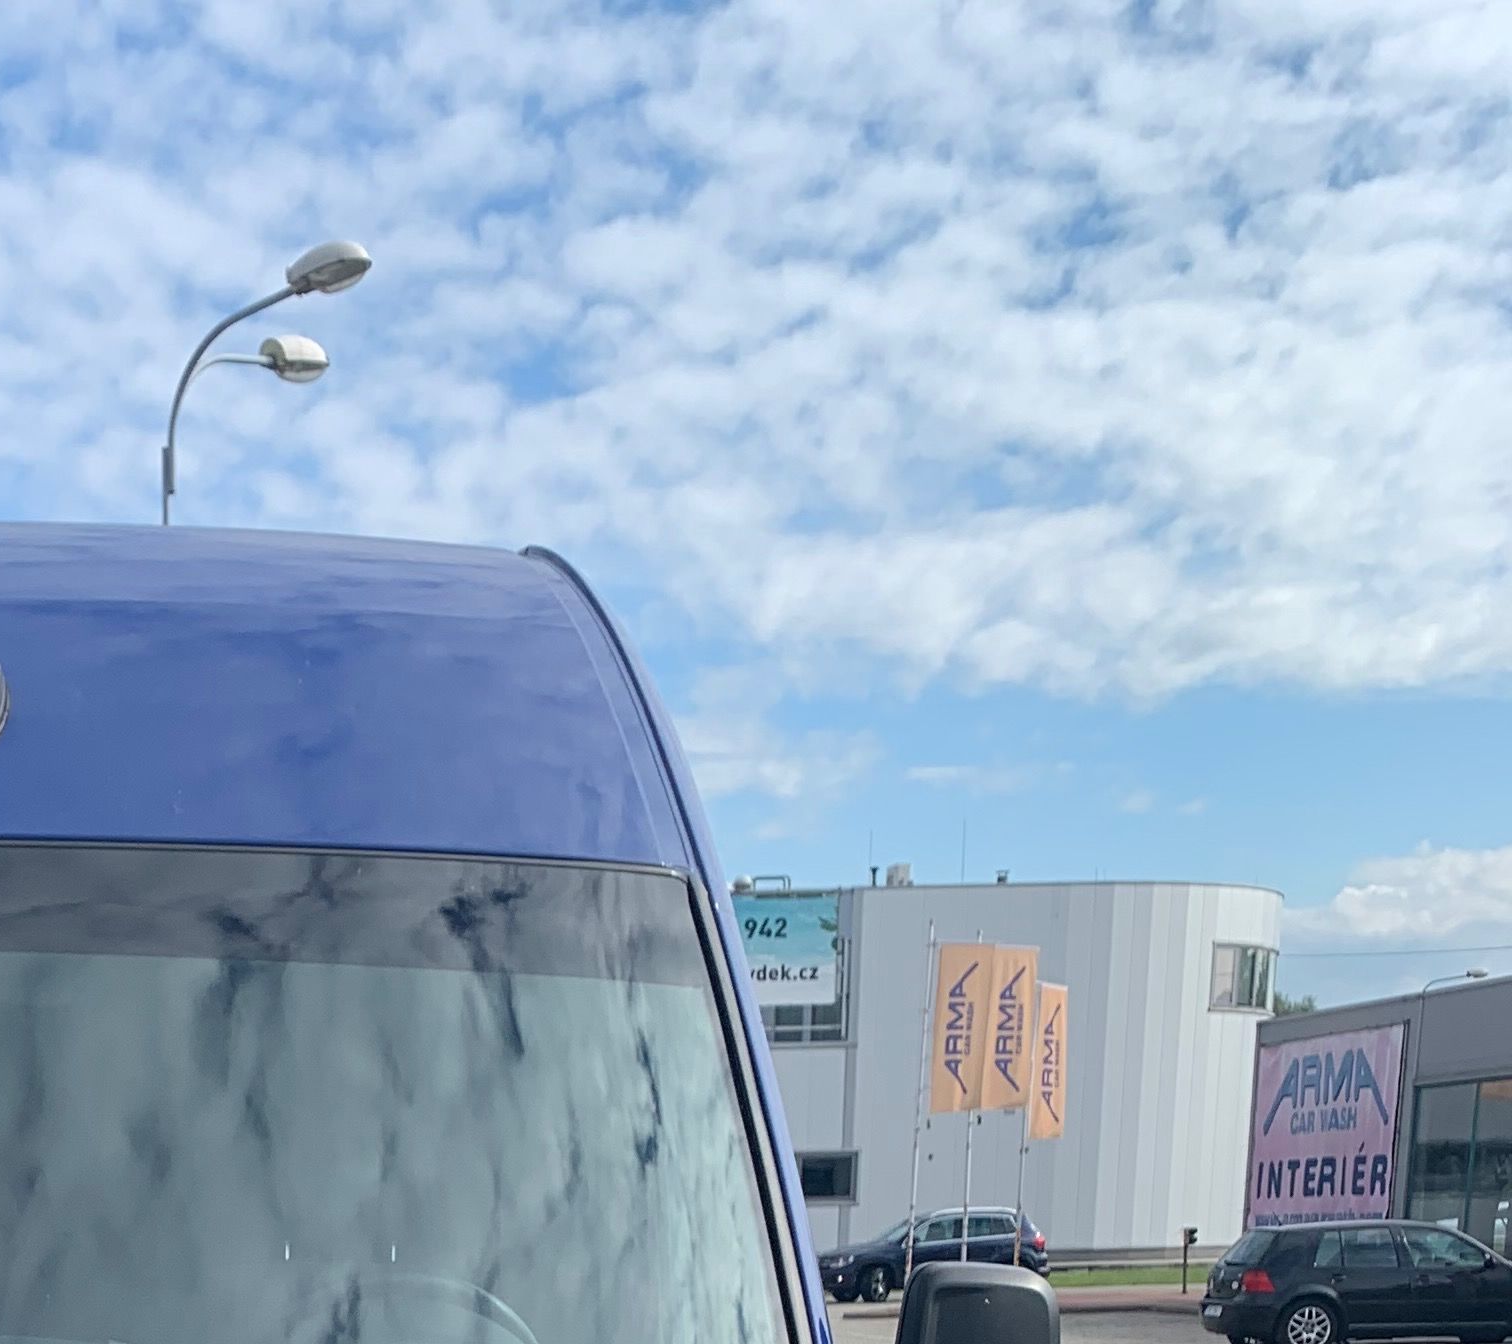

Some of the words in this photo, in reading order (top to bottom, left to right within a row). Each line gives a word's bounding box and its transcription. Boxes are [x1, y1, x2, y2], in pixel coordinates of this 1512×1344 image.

[744, 917, 788, 939] 942
[944, 960, 979, 1095] ARMA
[995, 965, 1027, 1093] ARMA
[1041, 1003, 1062, 1123] ARMA
[1263, 1047, 1389, 1137] ARMA
[1290, 1109, 1316, 1136] CAR
[1320, 1106, 1358, 1132] WASH
[1256, 1141, 1389, 1200] INTERIÉR
